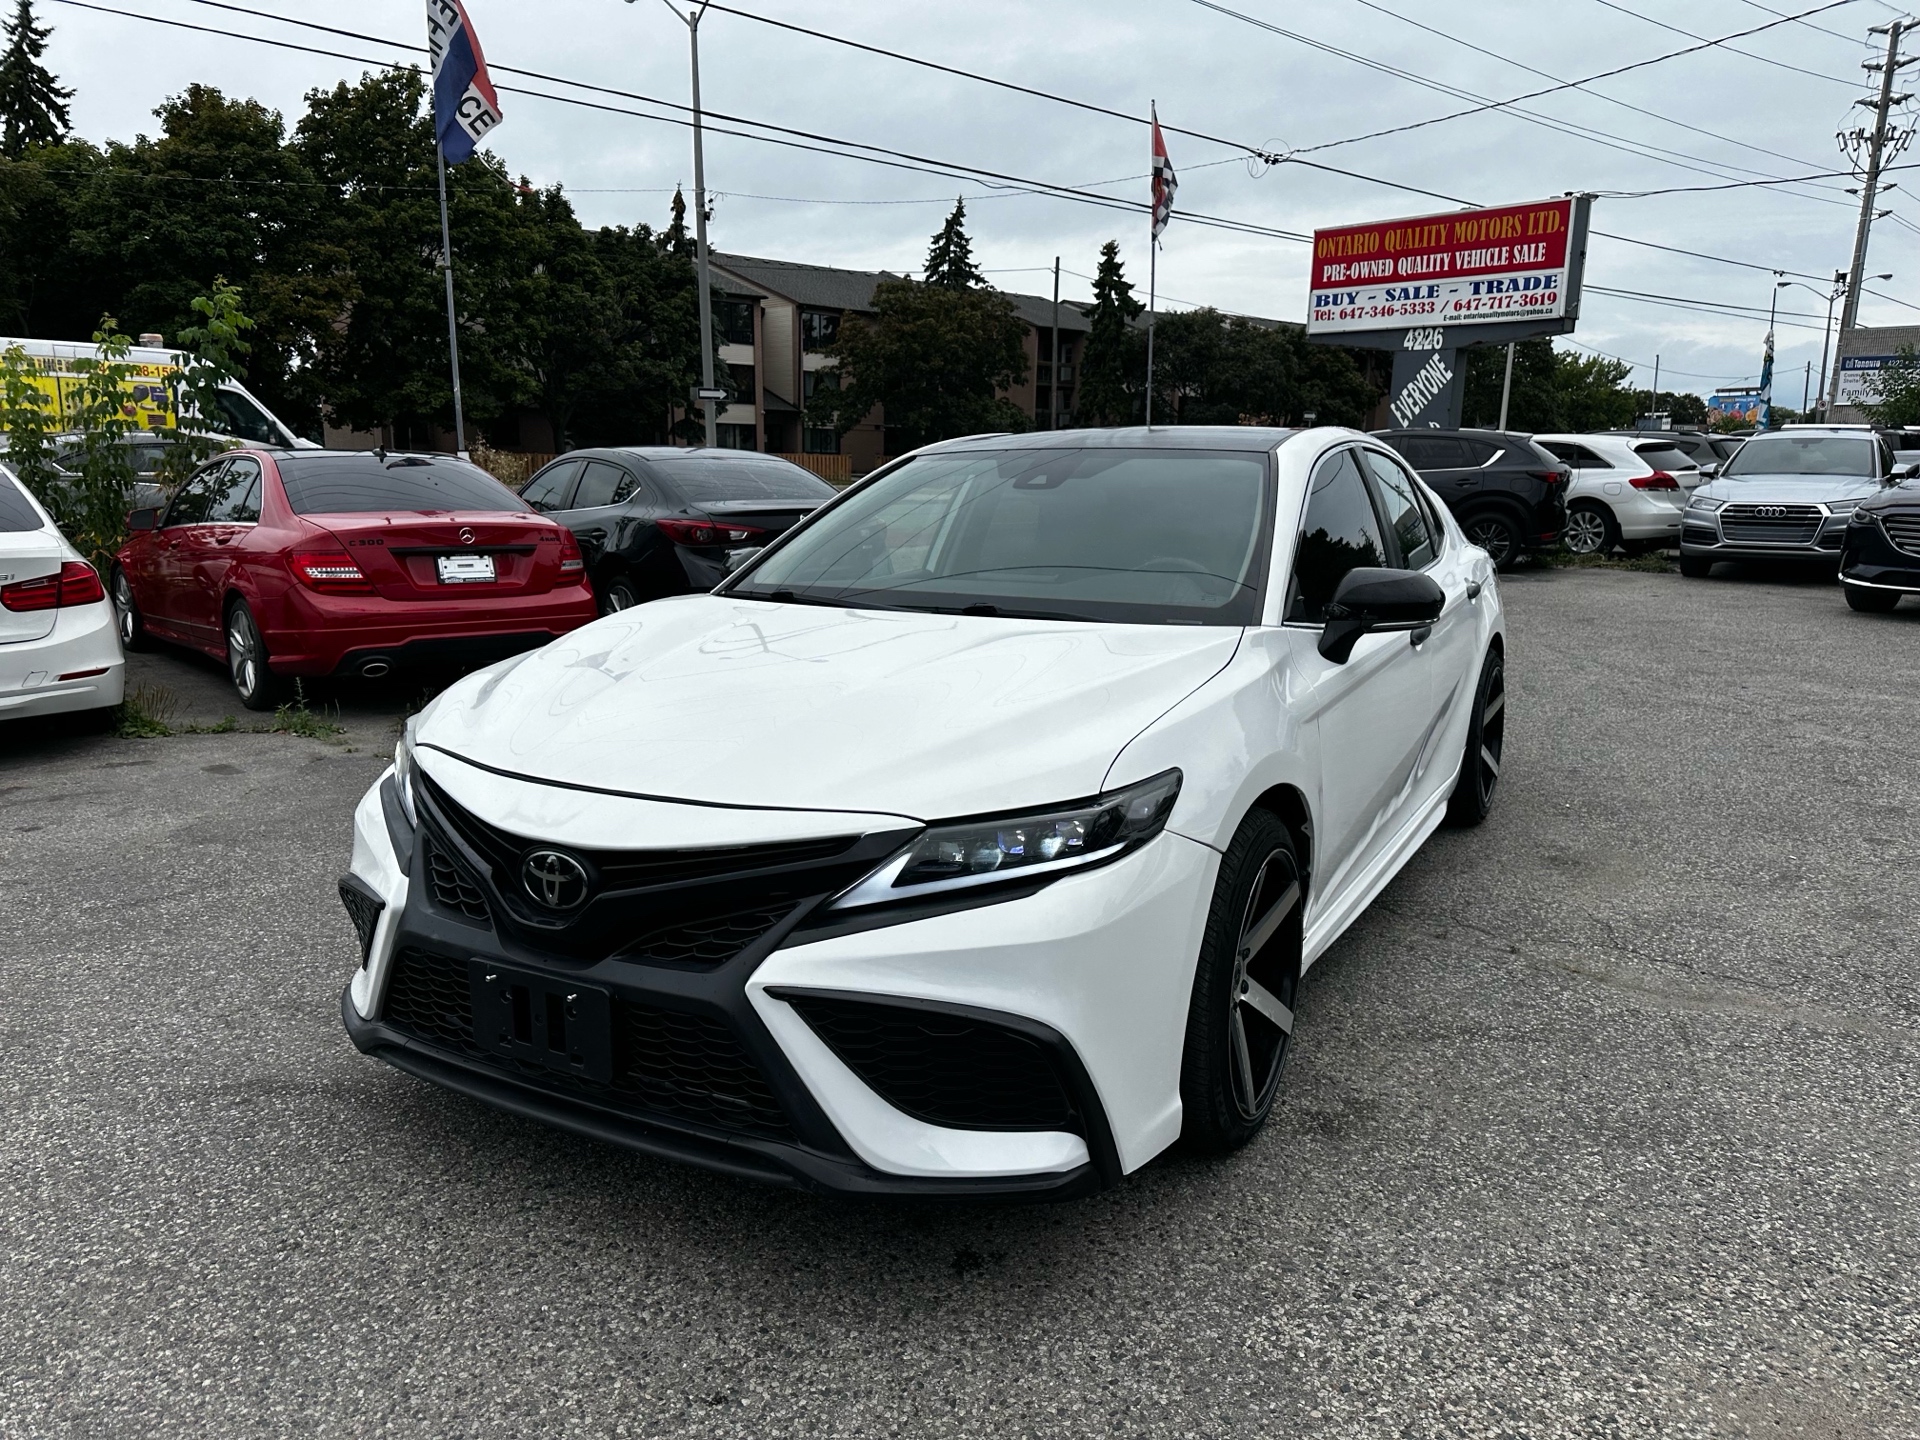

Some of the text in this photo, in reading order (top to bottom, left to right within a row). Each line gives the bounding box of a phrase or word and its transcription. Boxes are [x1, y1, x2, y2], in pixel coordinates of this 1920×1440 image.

[1317, 209, 1565, 259] ONTARIO QUALITY MOTORS LTD.
[1322, 242, 1546, 282] PRE-OWNED QUALITY VEHICLE SALE
[1314, 308, 1335, 321] Tel:
[1339, 301, 1435, 320] 647-346-5333
[1453, 291, 1557, 312] 647-717-3619
[1315, 291, 1360, 308] BUY
[1385, 285, 1440, 302] SALE
[1469, 275, 1558, 296] TRADE
[1443, 313, 1462, 321] E-mail:
[1403, 327, 1444, 351] 4226
[1390, 352, 1453, 429] EVERYONE
[1842, 388, 1870, 397] Family
